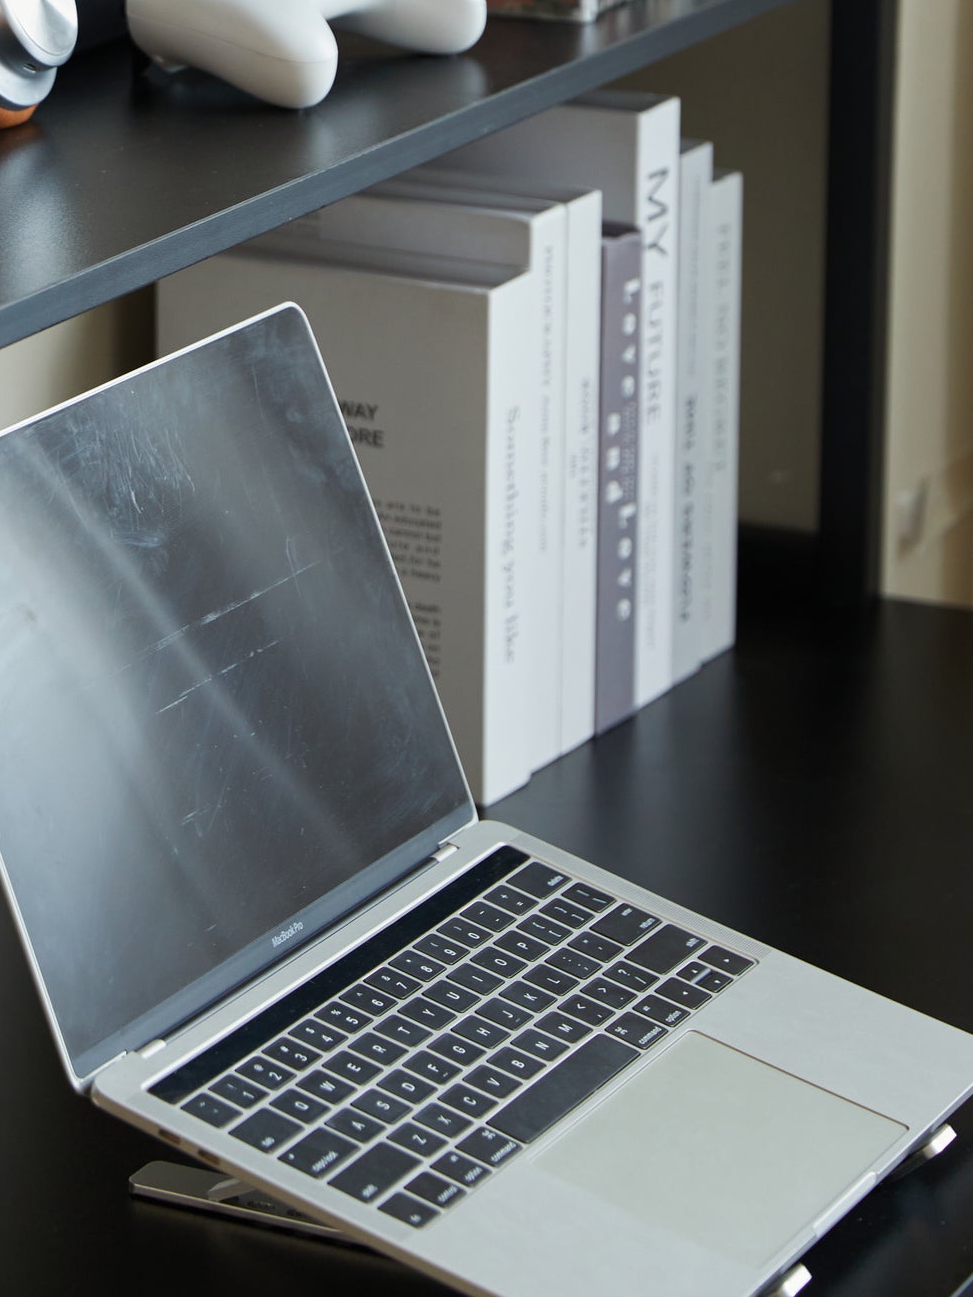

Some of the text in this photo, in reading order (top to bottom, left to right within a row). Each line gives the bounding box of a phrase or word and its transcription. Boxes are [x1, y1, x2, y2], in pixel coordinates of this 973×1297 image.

[644, 166, 671, 425] MY FUTURE
[620, 278, 642, 399] Love
[500, 406, 521, 665] Something you like
[615, 502, 638, 623] Love
[272, 922, 304, 948] MacBook Pro
[467, 932, 481, 940] 0
[516, 942, 529, 950] P
[443, 948, 457, 956] 9
[494, 958, 508, 966] O
[420, 965, 433, 973] 8
[471, 975, 484, 983] I
[395, 981, 408, 990] 7
[446, 991, 460, 1000] U
[523, 992, 538, 1002] K
[371, 998, 384, 1007] 6
[422, 1008, 435, 1017] Y
[502, 1010, 514, 1019] J
[345, 1016, 359, 1025] 5
[397, 1026, 411, 1035] T
[476, 1027, 491, 1037] H
[557, 1023, 573, 1033] M
[321, 1034, 334, 1043] 4
[638, 1025, 663, 1045] command
[372, 1044, 387, 1054] R
[452, 1045, 466, 1054] G
[534, 1041, 550, 1051] N
[294, 1053, 308, 1062] 3
[346, 1062, 362, 1073] E
[427, 1063, 439, 1073] F
[511, 1059, 525, 1069] B
[268, 1071, 283, 1081] 2
[319, 1080, 336, 1093] W
[401, 1082, 416, 1092] D
[486, 1077, 500, 1087] V
[242, 1090, 255, 1099] 1
[294, 1100, 310, 1111] Q
[376, 1100, 390, 1110] S
[463, 1096, 477, 1106] C
[437, 1114, 452, 1125] X
[351, 1120, 366, 1131] A
[412, 1133, 427, 1145] Z
